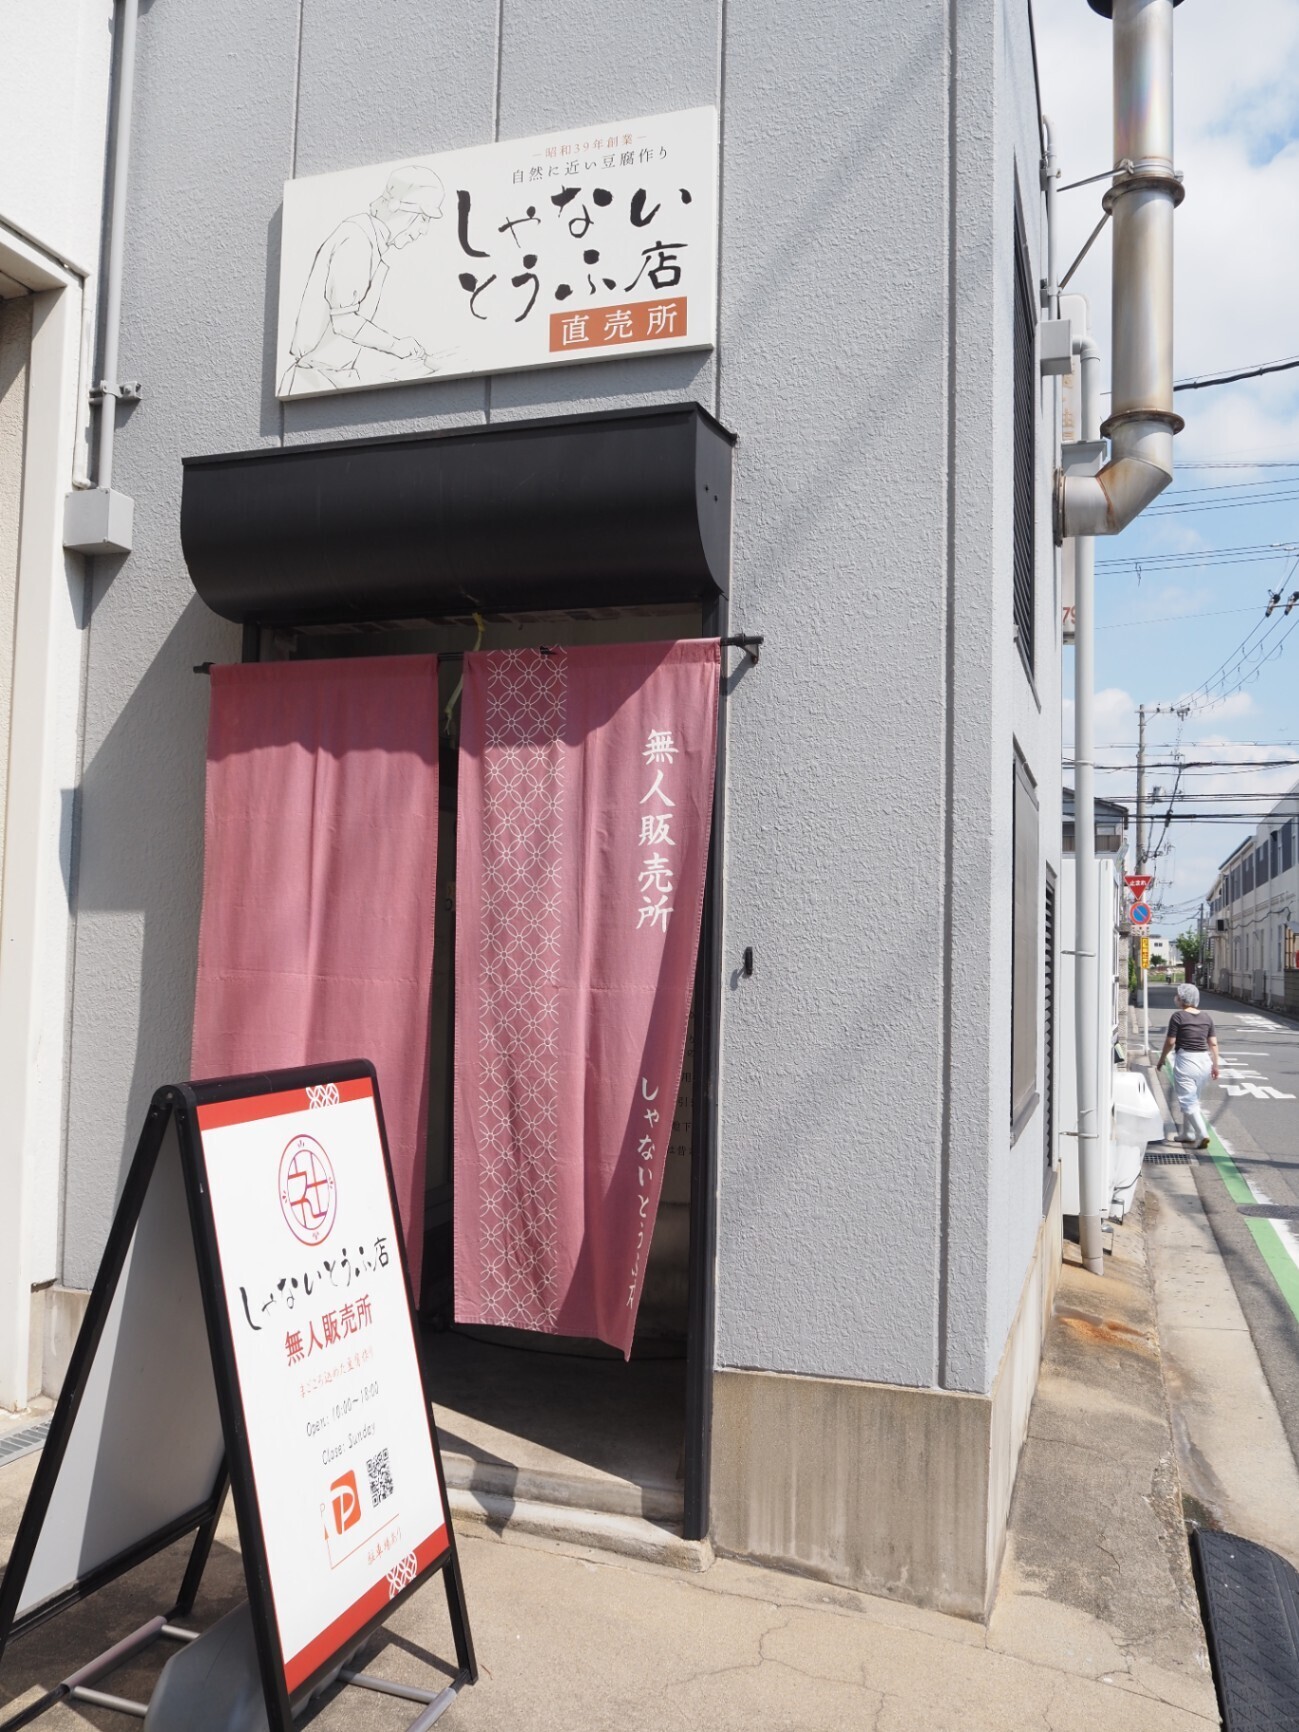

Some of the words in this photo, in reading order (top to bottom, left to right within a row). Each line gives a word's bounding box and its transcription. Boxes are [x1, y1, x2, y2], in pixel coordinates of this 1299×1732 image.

[512, 146, 668, 184] 自然に近い豆腐作り
[545, 134, 633, 159] 昭和39年創業
[456, 185, 692, 258] しゃない
[458, 241, 688, 323] とうふ店
[561, 303, 677, 346] 直売所
[636, 729, 679, 933] 無人販売所
[239, 1237, 389, 1330] しゃないとうふ店
[285, 1294, 372, 1367] 無人販売所
[348, 1422, 375, 1449] Sunday
